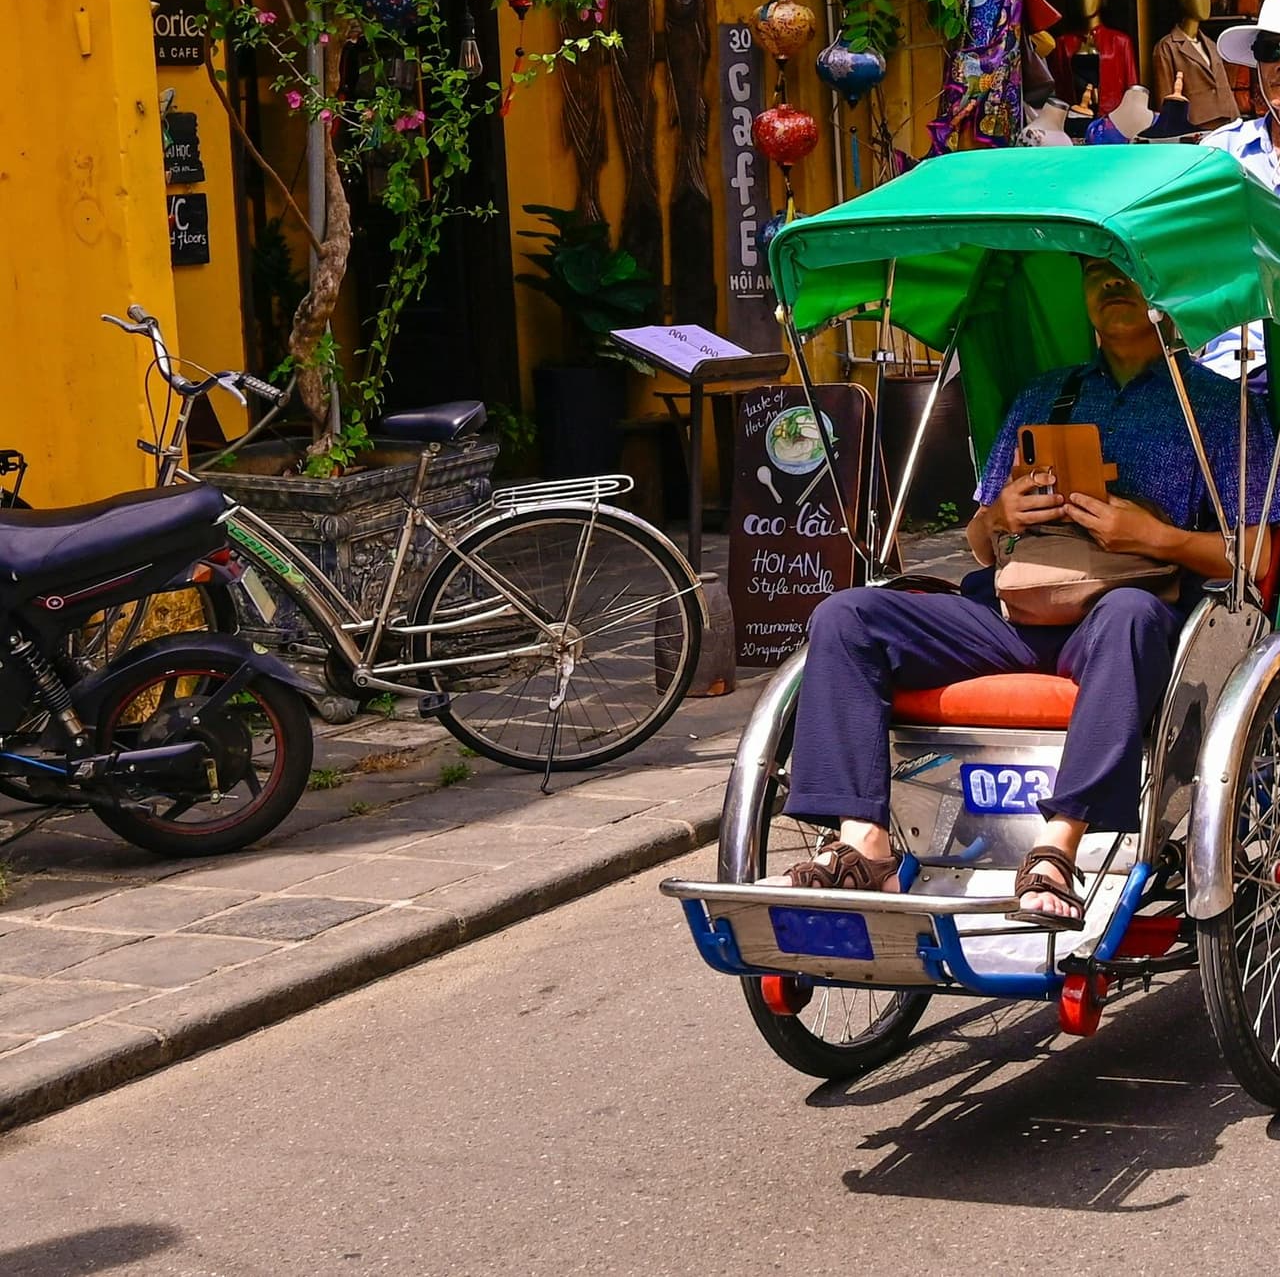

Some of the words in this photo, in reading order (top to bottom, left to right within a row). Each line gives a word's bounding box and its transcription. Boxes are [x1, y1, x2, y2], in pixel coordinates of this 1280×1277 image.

[729, 28, 751, 50] 30
[170, 47, 199, 58] CAFE
[730, 271, 752, 293] HỘI
[756, 275, 773, 290] AN
[743, 395, 771, 417] taste
[773, 389, 786, 409] of
[752, 549, 785, 573] HOI
[788, 551, 820, 578] AN
[747, 577, 791, 601] Style
[793, 569, 835, 595] noodle
[746, 619, 802, 635] memories
[970, 769, 1053, 809] 023
